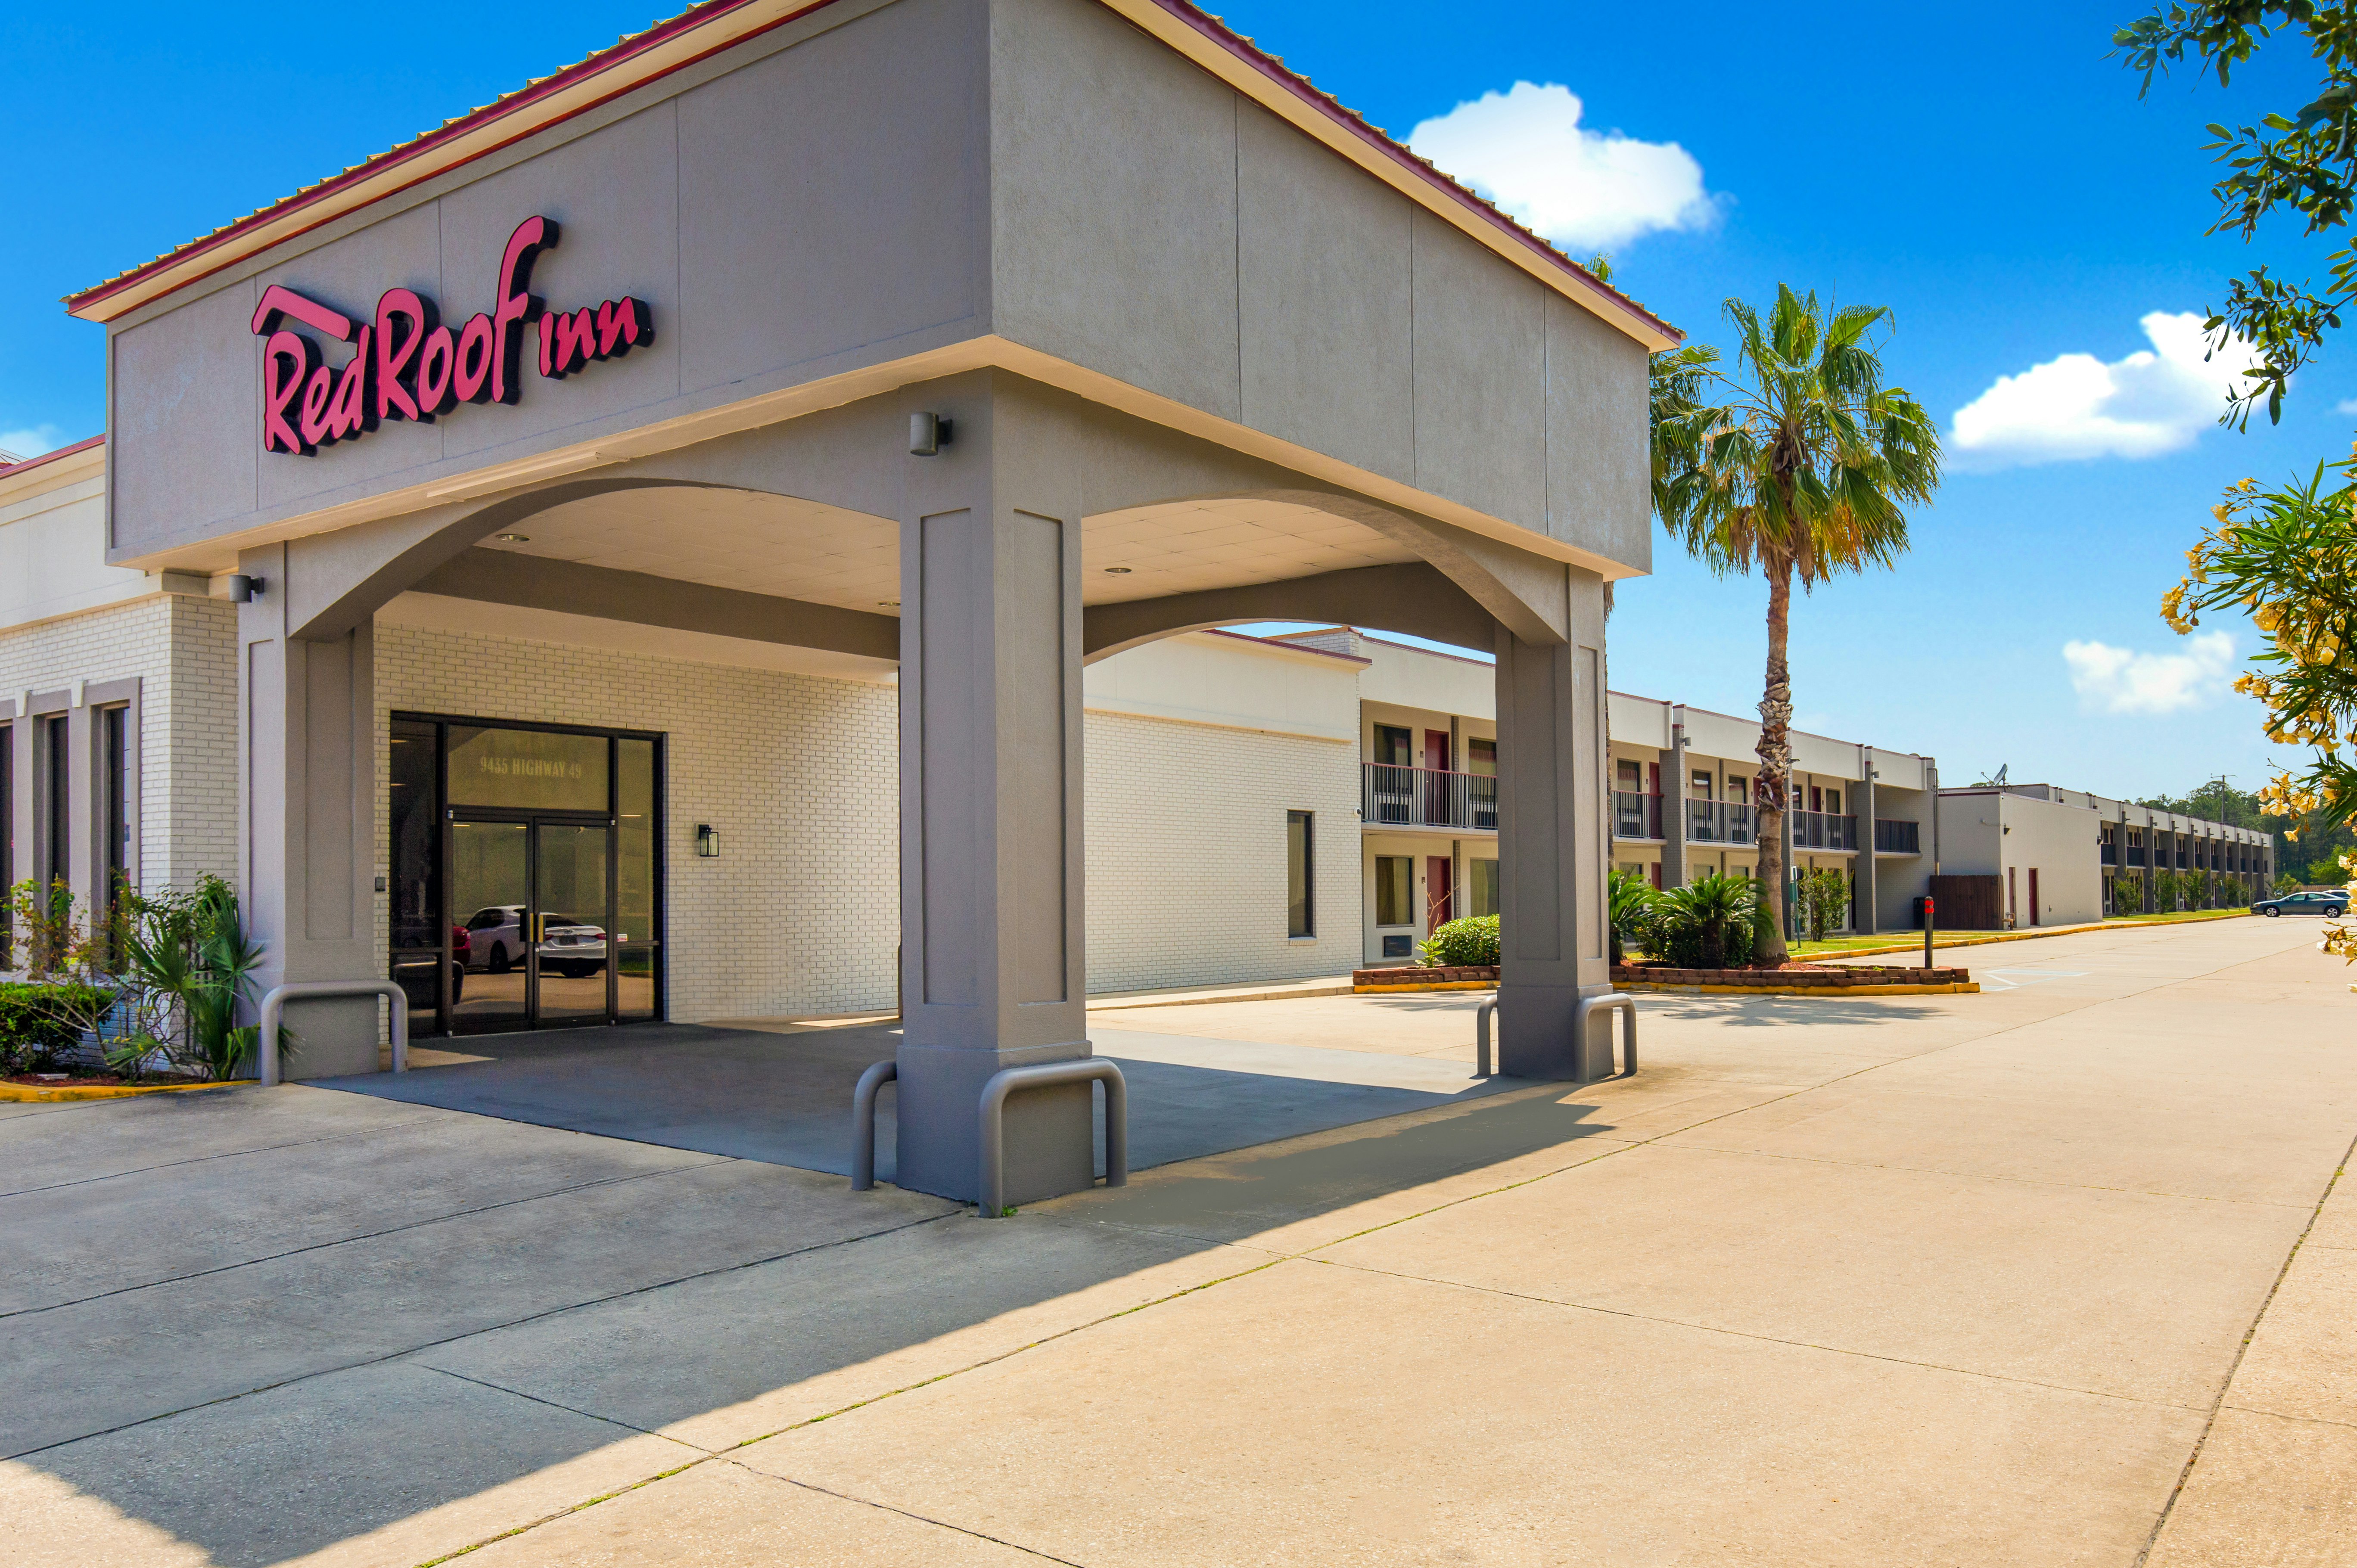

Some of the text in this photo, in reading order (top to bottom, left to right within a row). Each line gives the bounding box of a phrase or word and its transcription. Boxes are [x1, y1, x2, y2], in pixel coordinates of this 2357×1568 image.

[480, 756, 581, 779] 9435 HIGHWAY 49
